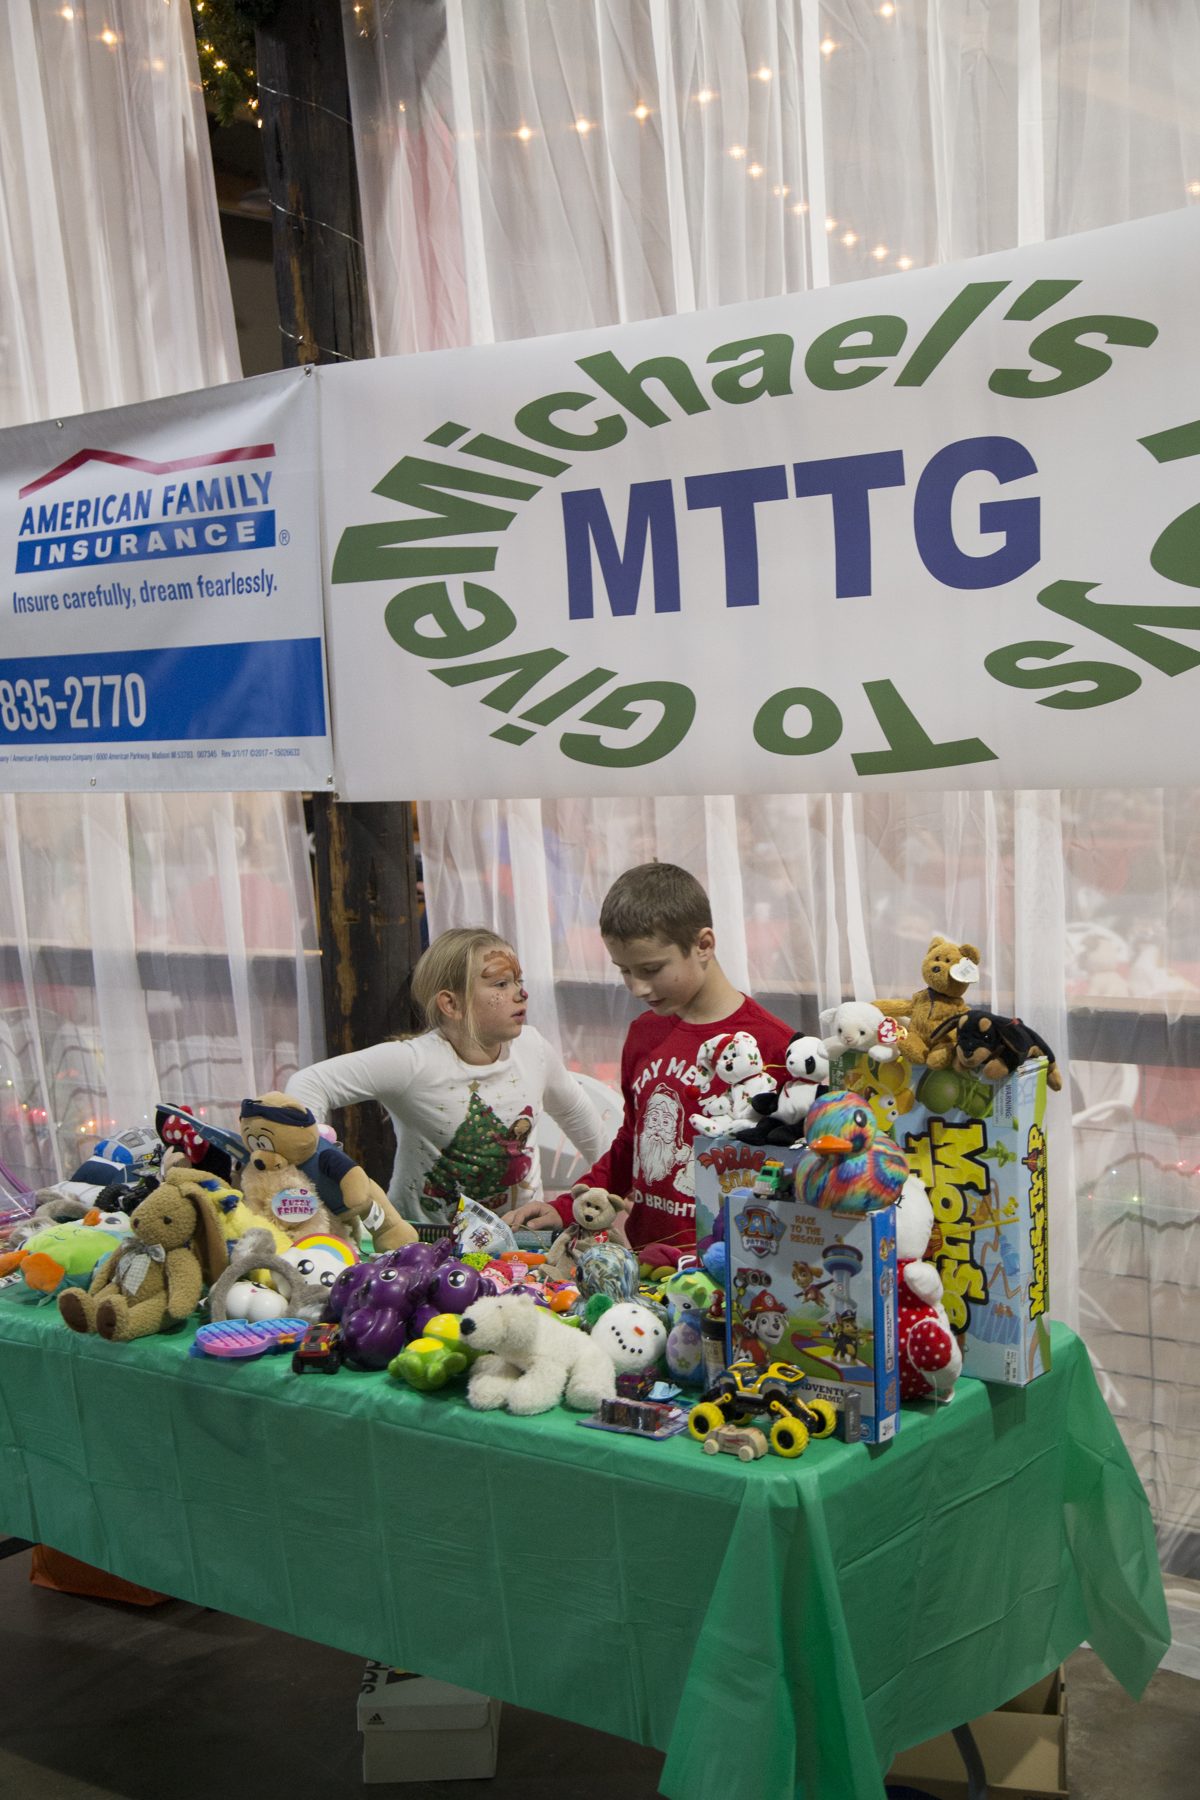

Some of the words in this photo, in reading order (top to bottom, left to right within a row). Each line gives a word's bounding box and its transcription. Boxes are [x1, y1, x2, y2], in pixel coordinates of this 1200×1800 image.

[331, 279, 1159, 586] Michael's
[18, 488, 152, 536] AMERICAN
[162, 470, 273, 517] FAMILY
[33, 519, 256, 566] INSURANCE
[560, 435, 1041, 621] MTTG
[13, 591, 60, 614] Insure
[63, 581, 137, 610] carefully,
[140, 580, 194, 604] dream
[196, 568, 278, 601] fearlessly.
[984, 419, 1200, 711] oys
[383, 580, 697, 769] Give
[752, 678, 999, 776] To
[277, 1206, 314, 1216] FRIENDS
[281, 1198, 311, 1207] FUZZY
[645, 1193, 697, 1218] BRIGHT
[928, 1117, 990, 1336] Mouse
